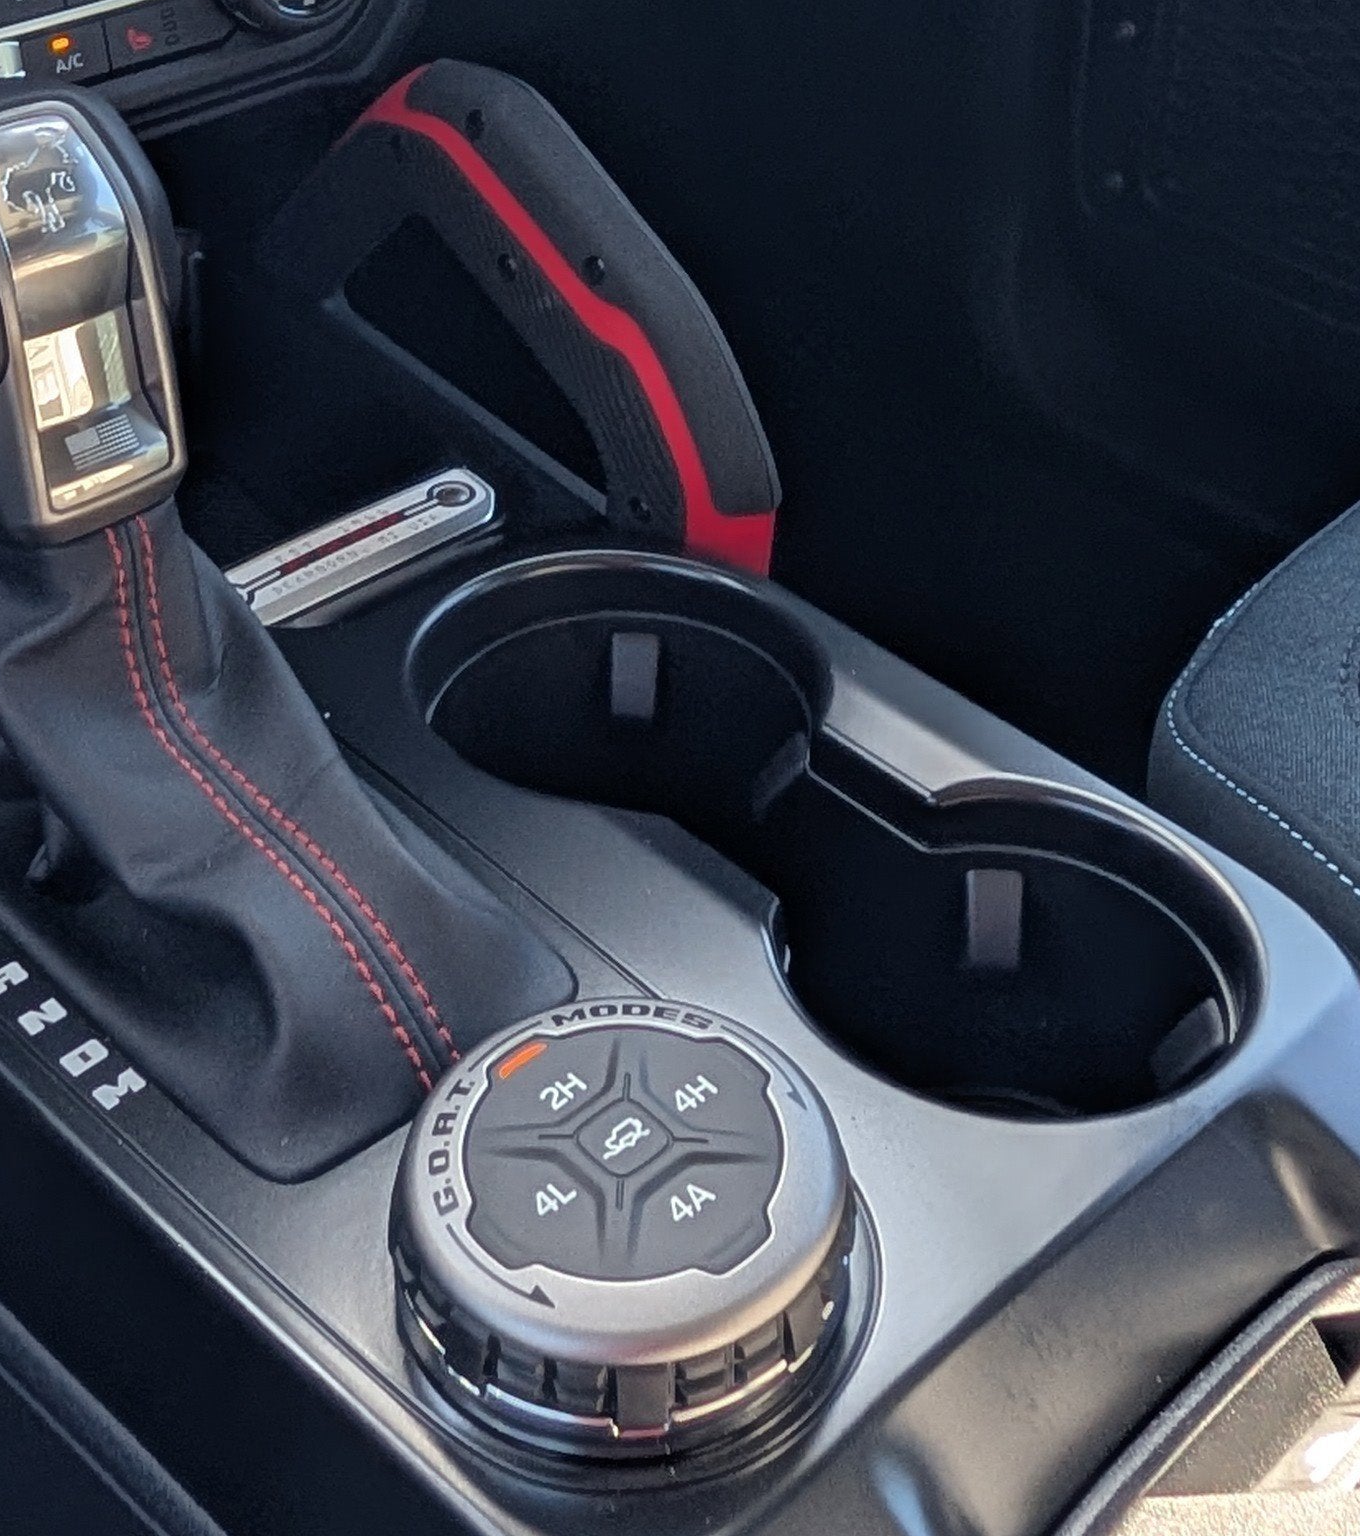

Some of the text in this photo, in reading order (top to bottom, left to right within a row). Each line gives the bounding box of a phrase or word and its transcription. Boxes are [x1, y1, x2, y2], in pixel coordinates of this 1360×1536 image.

[55, 53, 84, 74] A/C
[17, 997, 68, 1036] N
[551, 1003, 716, 1030] MODES
[58, 1038, 109, 1077] D
[92, 1067, 147, 1110] M
[541, 1073, 587, 1111] 2H
[673, 1074, 719, 1113] 4H
[534, 1184, 577, 1217] 4L
[669, 1183, 717, 1223] 4A
